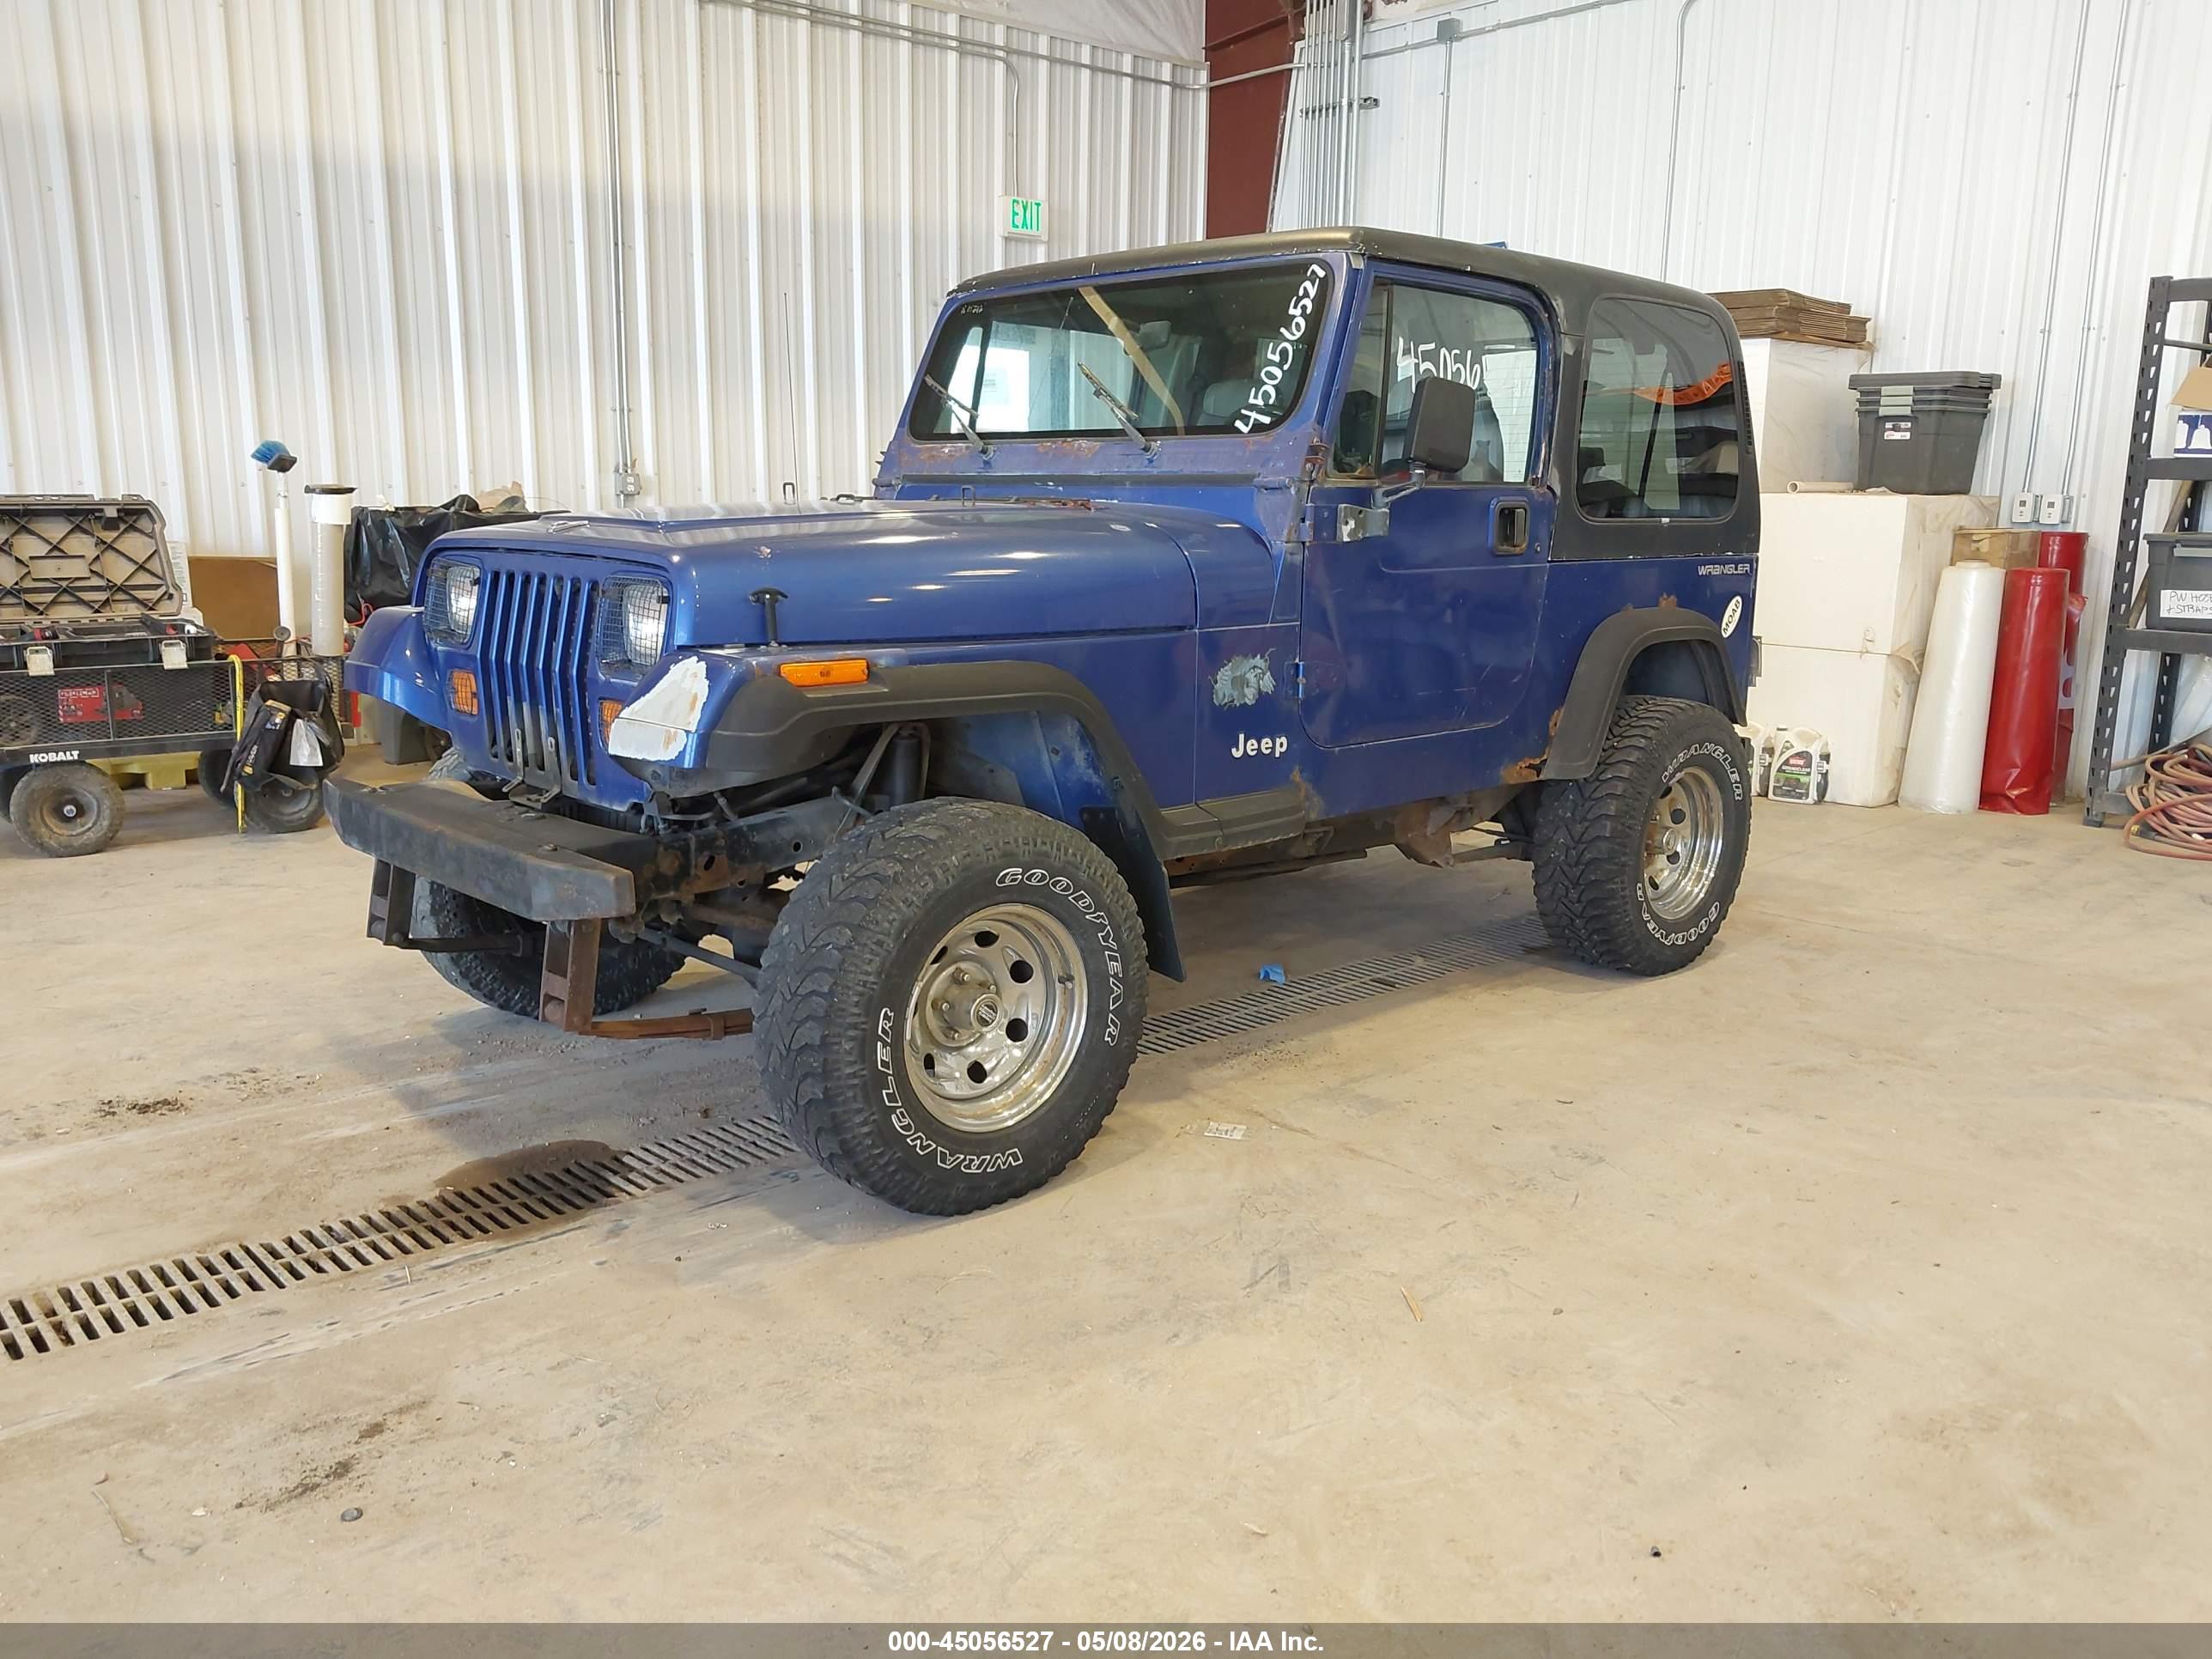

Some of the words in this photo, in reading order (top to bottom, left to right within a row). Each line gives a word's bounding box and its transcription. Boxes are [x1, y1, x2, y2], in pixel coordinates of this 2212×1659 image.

[1012, 198, 1042, 232] EXIT
[1234, 264, 1327, 434] 45056527
[1698, 563, 1752, 576] WRANGLER
[1723, 599, 1741, 635] MOAB
[29, 750, 80, 763] KOBALT
[1231, 733, 1288, 758] Jeep
[1662, 742, 1743, 801] WRANGLER
[1637, 883, 1720, 945] GOODYEAR
[995, 868, 1124, 1046] GOODYEAR
[877, 1007, 1024, 1173] WRANGLER
